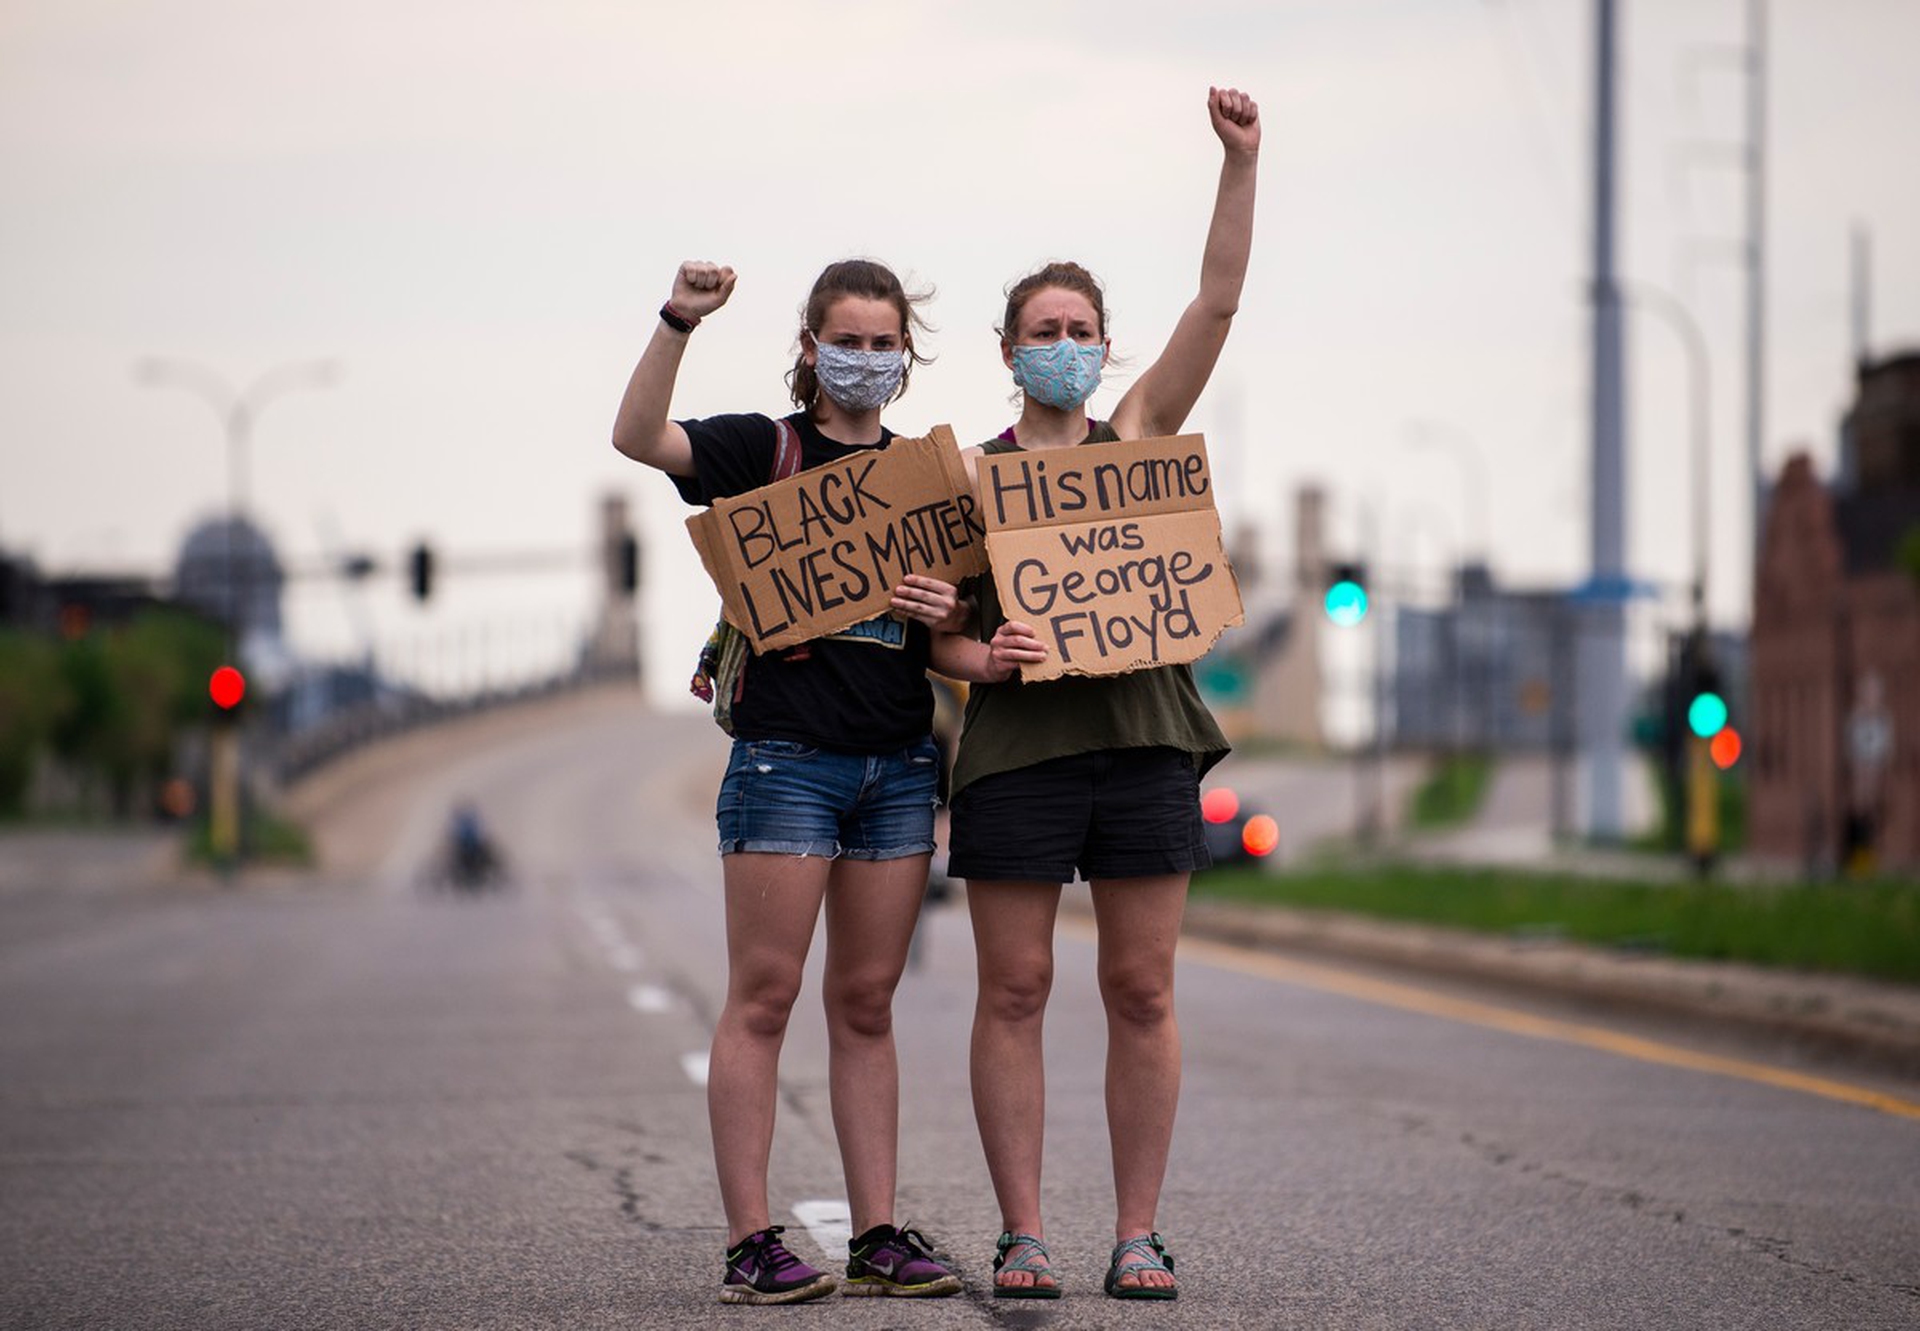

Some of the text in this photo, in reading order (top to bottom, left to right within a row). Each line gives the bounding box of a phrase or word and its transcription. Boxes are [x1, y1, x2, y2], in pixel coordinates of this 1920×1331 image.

[728, 458, 892, 569] BLACK
[991, 454, 1208, 524] His name
[740, 494, 986, 641] LIVES MATTER
[1060, 523, 1144, 557] was
[1013, 551, 1213, 616] George
[1050, 589, 1201, 663] Floyd
